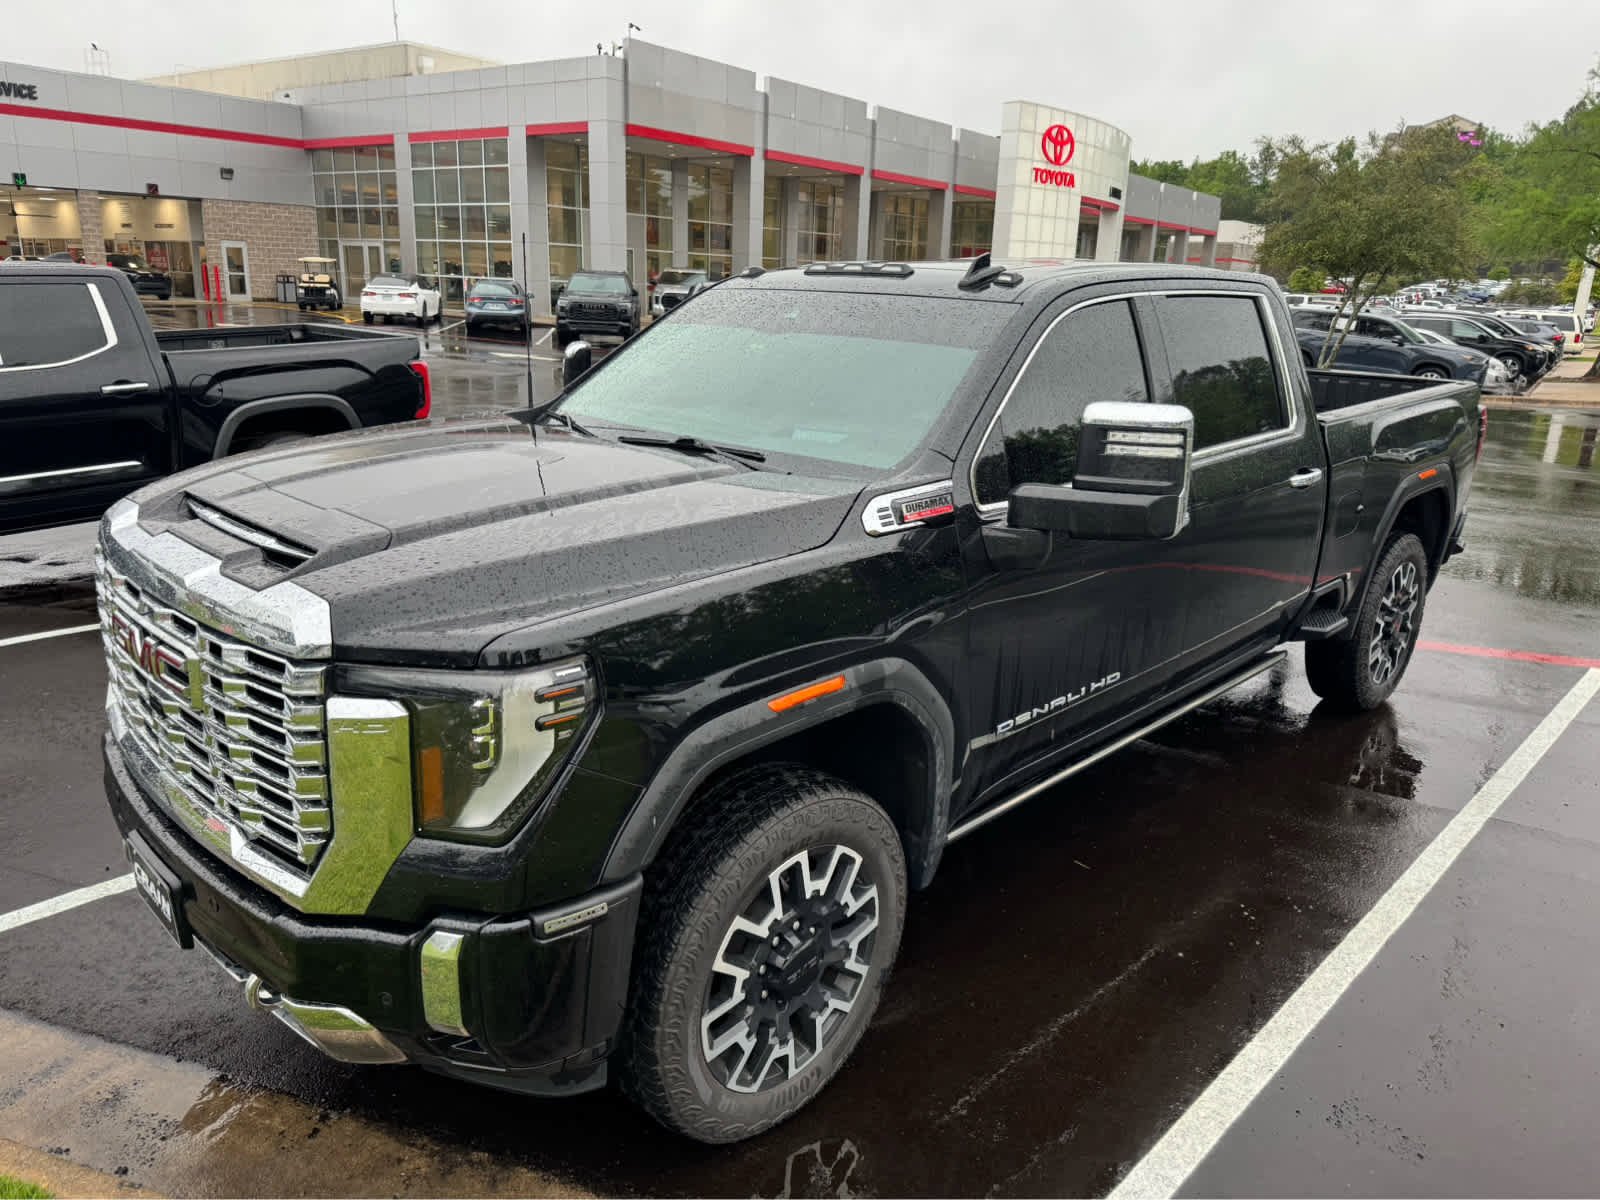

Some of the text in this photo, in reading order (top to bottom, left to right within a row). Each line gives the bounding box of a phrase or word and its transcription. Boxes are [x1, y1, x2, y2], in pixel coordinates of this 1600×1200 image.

[1033, 167, 1075, 188] TOYOTA
[904, 495, 951, 514] DURAMAX
[996, 672, 1121, 737] DENALI HD
